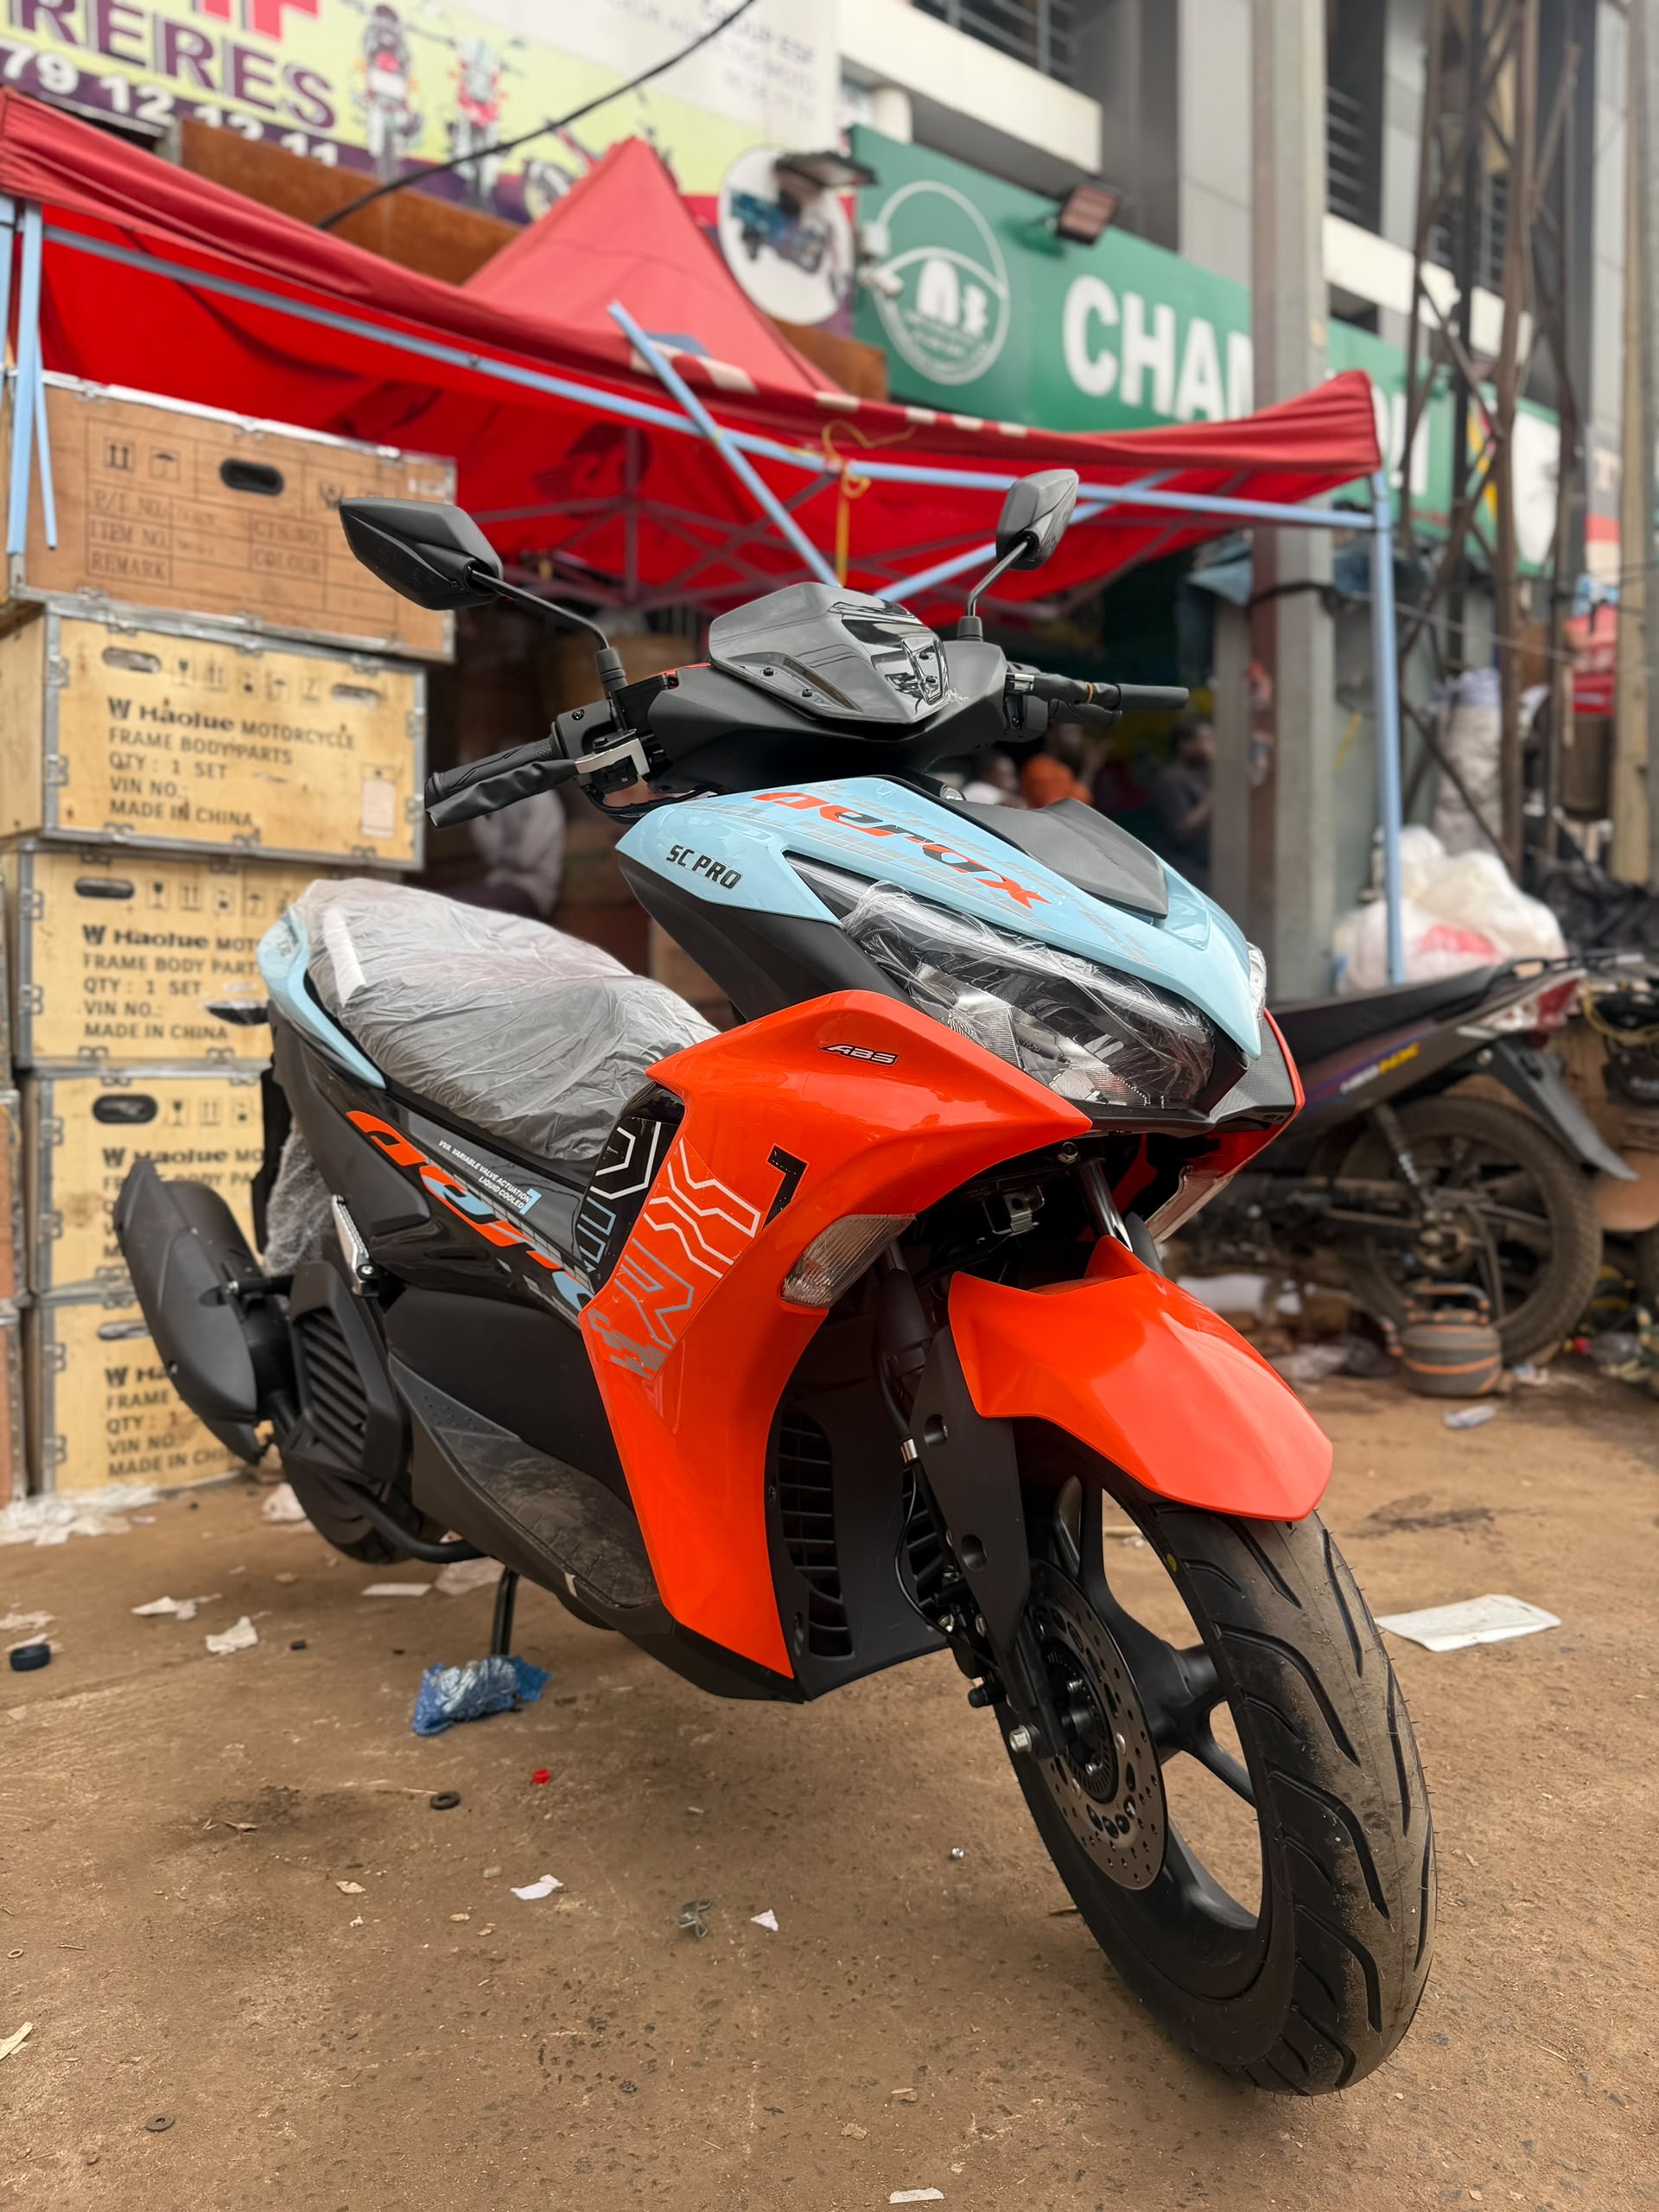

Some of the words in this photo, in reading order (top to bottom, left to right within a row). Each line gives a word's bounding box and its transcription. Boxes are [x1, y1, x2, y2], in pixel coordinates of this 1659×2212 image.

[91, 550, 167, 581] REMARK
[109, 727, 173, 751] FRAME
[241, 719, 355, 751] MOTORCYCLE
[194, 761, 227, 779] SET
[109, 775, 142, 794] VIN
[109, 798, 164, 820] MADE
[170, 801, 190, 822] IN
[195, 807, 252, 826] CHINA
[665, 843, 696, 868] SC
[691, 854, 742, 890] PRO
[83, 953, 147, 971] FRAME
[154, 957, 205, 973] BODY
[211, 958, 261, 976] PART
[168, 981, 202, 995] SET
[84, 1001, 117, 1015] VIN
[84, 1023, 141, 1038] MADE
[144, 1024, 164, 1038] IN
[170, 1025, 228, 1039] CHINA
[824, 1044, 898, 1065] ABS
[451, 1147, 482, 1170] VARIABLE
[478, 1165, 499, 1182] VALVE
[496, 1176, 533, 1203] ACTUATION
[478, 1175, 500, 1194] LIQUID
[498, 1189, 525, 1210] COOLED
[105, 1389, 168, 1410] FRAME
[106, 1438, 140, 1455] VIN
[107, 1456, 161, 1477] MADE
[167, 1452, 188, 1469] IN
